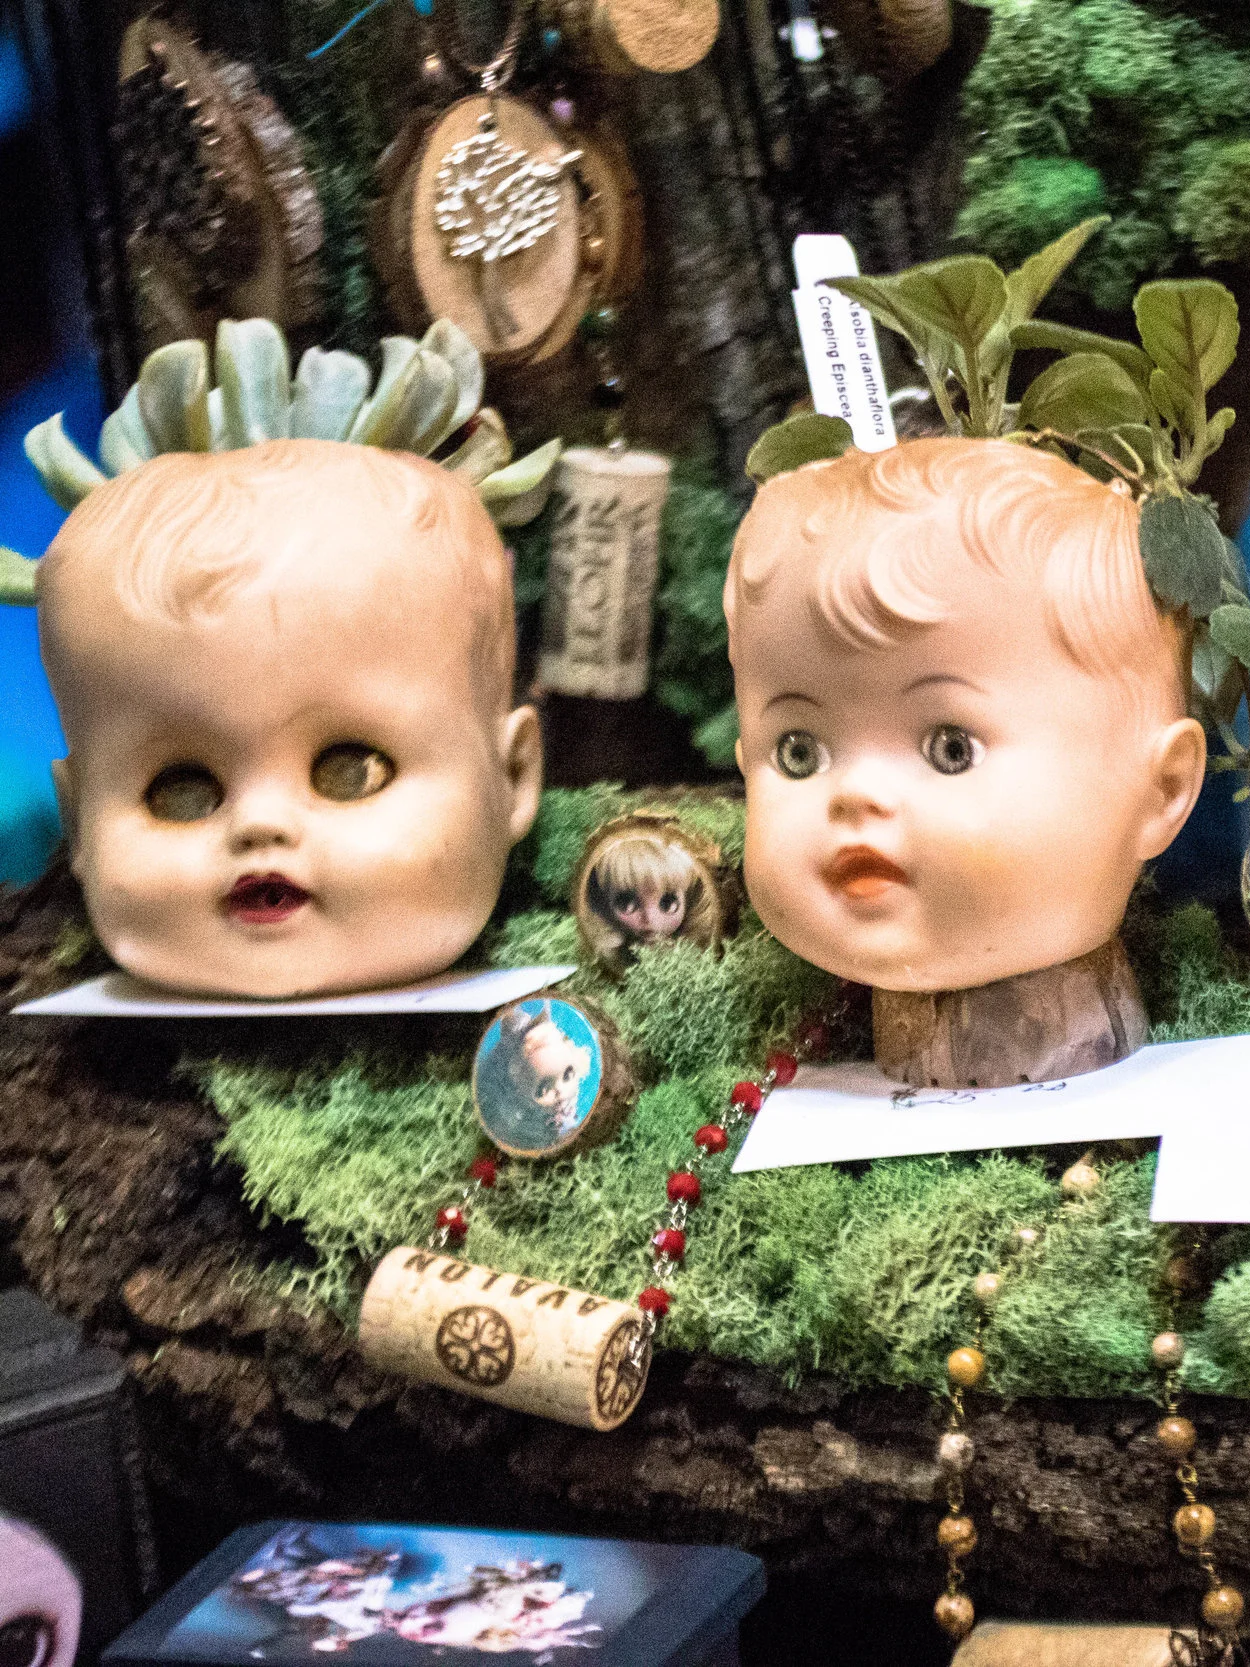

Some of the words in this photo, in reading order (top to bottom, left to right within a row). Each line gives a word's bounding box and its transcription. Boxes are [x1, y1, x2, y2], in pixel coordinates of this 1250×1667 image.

[818, 295, 840, 359] Creeping
[830, 363, 852, 419] Episcea
[859, 352, 885, 436] dianthaflora
